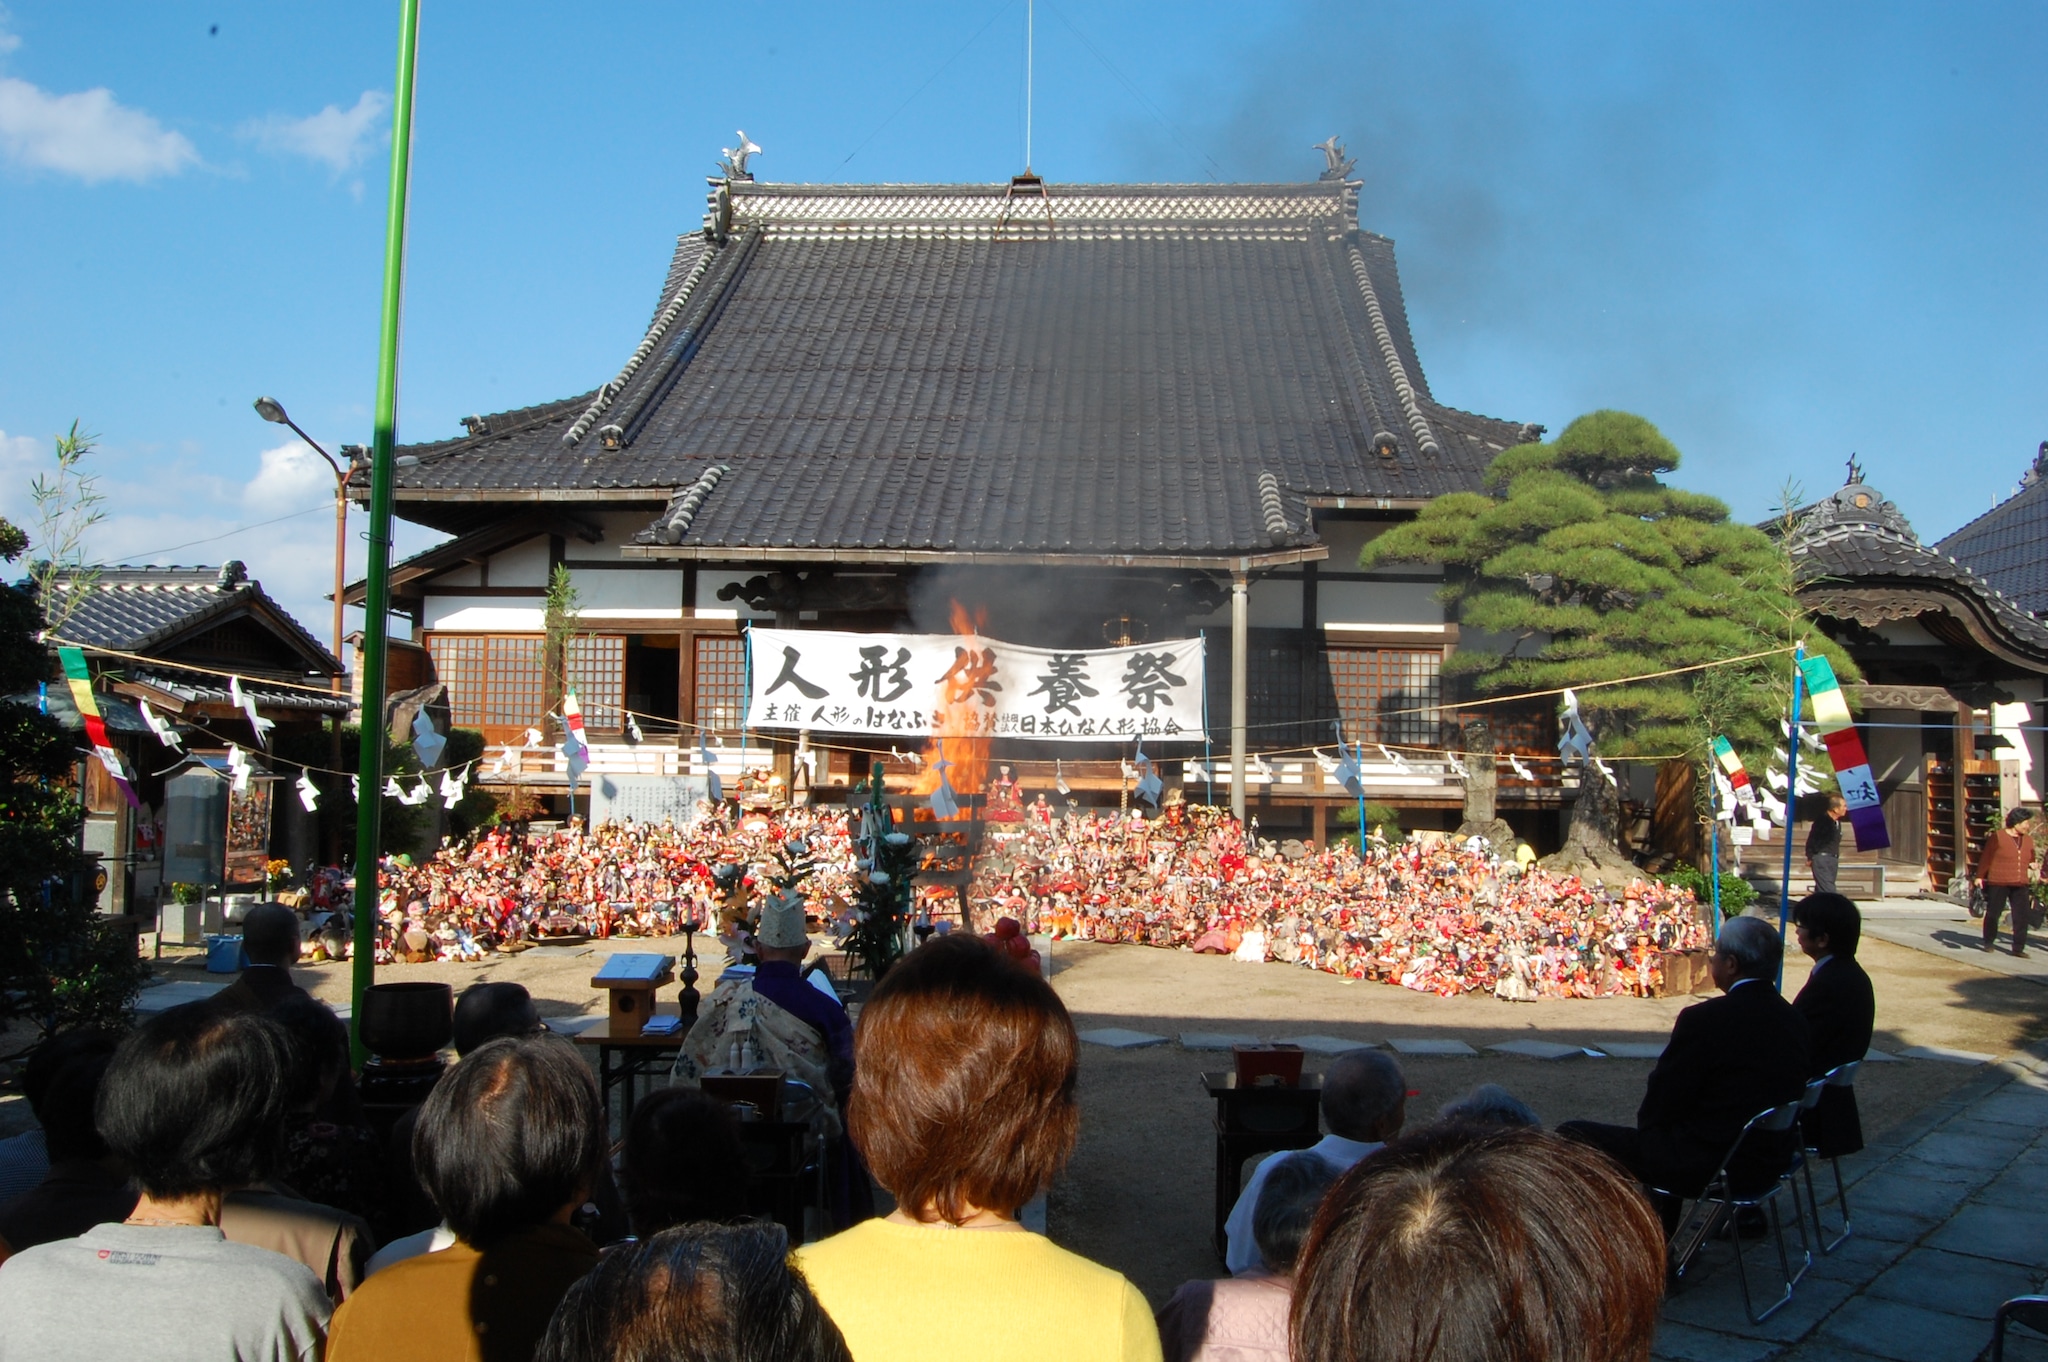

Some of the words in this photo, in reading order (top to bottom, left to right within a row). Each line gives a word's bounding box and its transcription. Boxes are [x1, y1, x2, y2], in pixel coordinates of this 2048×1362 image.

[764, 644, 1188, 717] 人形供養祭
[762, 702, 802, 723] 主催
[1020, 714, 1183, 736] 日本ひな人形協会
